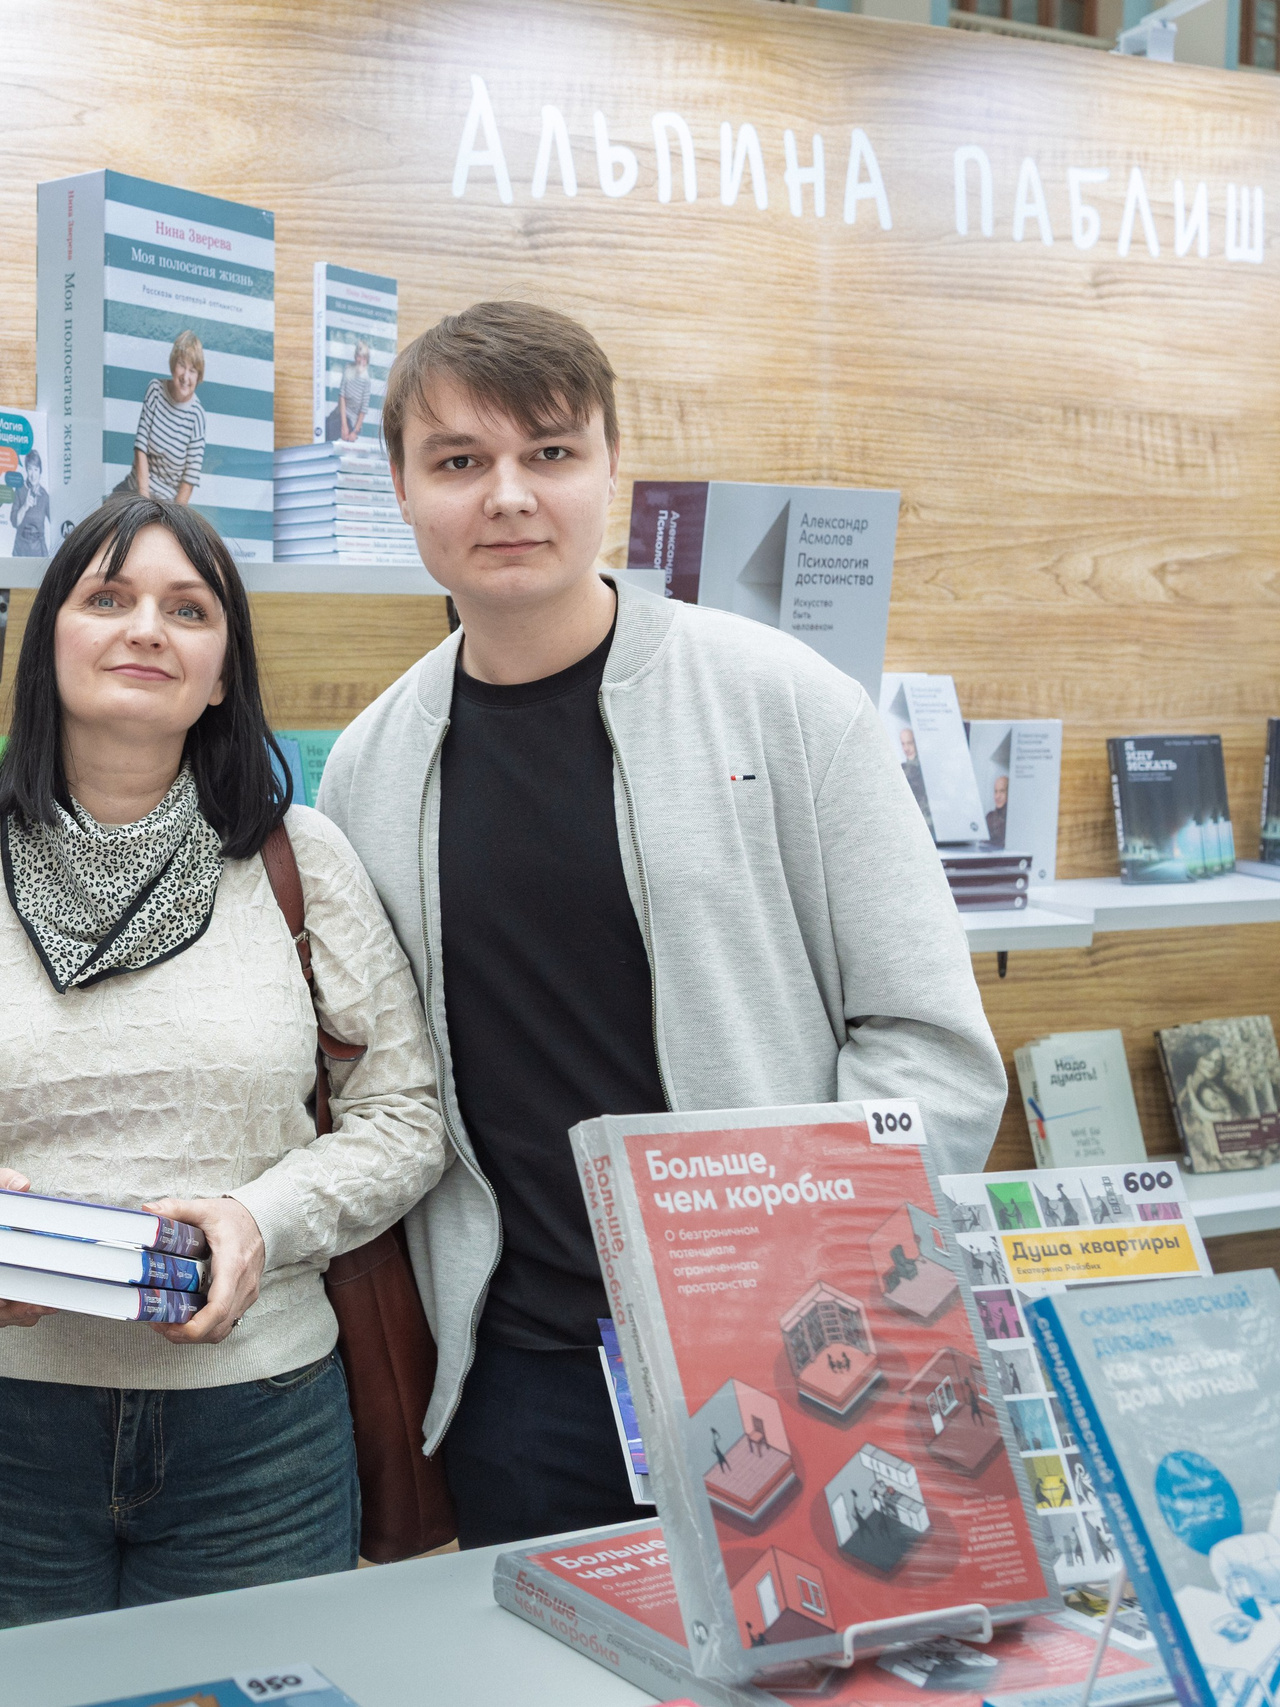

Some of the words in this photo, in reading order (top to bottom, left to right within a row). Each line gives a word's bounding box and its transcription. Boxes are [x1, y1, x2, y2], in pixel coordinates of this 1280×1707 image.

[155, 220, 185, 240] Нина
[189, 228, 232, 252] Зверева
[131, 246, 156, 266] Моя
[159, 256, 216, 280] полосатая
[219, 268, 254, 288] жизнь
[64, 272, 75, 312] Моя
[63, 319, 74, 416] полосатая
[63, 424, 72, 485] жизнь
[801, 513, 869, 534] Александр
[665, 510, 680, 584] Александр
[799, 530, 853, 546] Асмолов
[797, 553, 869, 573] Психология
[795, 570, 874, 588] достоинства
[793, 610, 811, 620] быть
[794, 598, 833, 609] Искусство
[1050, 1068, 1097, 1087] думать!
[1054, 1059, 1087, 1072] Надо
[645, 1150, 776, 1181] Больше,
[1123, 1171, 1173, 1193] 600
[654, 1187, 718, 1214] чем
[725, 1173, 856, 1216] коробка
[593, 1155, 625, 1261] Больше,
[679, 1225, 760, 1242] безграничном
[669, 1244, 736, 1260] потенциале
[1013, 1241, 1072, 1262] Душа
[1080, 1236, 1180, 1257] квартиры
[595, 1218, 627, 1326] коробка
[673, 1260, 760, 1278] ограниченного
[677, 1278, 758, 1296] пространства
[1080, 1284, 1252, 1327] скандинавский
[1037, 1316, 1115, 1485] скандинавский
[576, 1562, 640, 1580] чем
[515, 1570, 579, 1627] Больше,
[550, 1614, 620, 1667] коробка
[247, 1675, 303, 1696] 950
